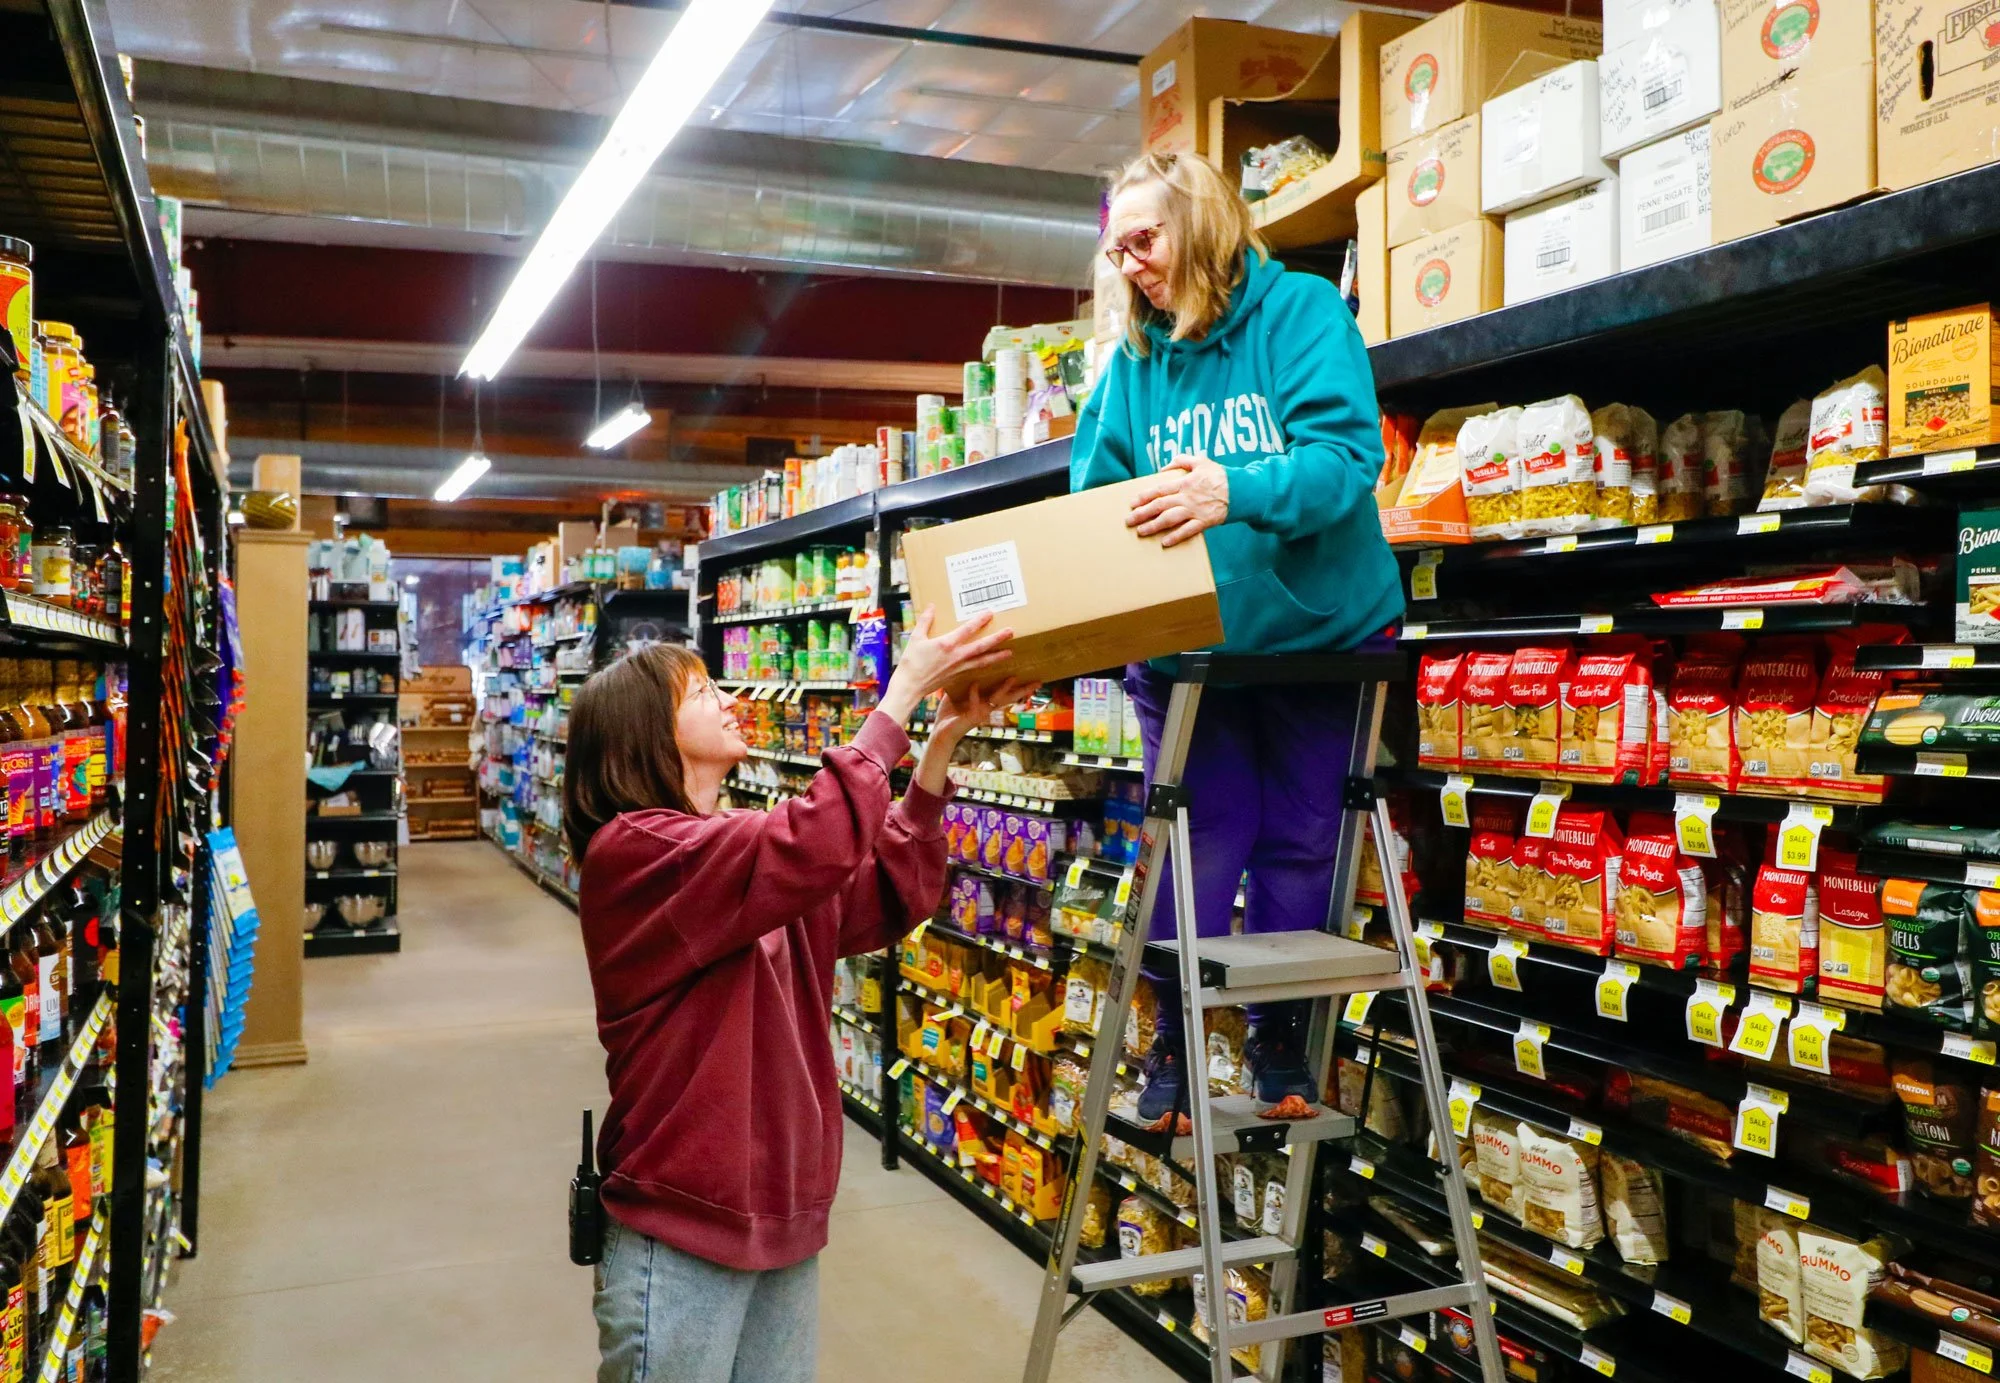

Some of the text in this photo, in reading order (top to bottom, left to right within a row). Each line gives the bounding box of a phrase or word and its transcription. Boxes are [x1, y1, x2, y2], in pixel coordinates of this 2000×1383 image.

[1900, 119, 1925, 135] PRODUCE
[1637, 184, 1692, 212] PENNE RIGATE
[1892, 315, 1984, 367] Bionaturae
[1905, 374, 1970, 390] SOURDOUGH
[970, 548, 1009, 562] MANTOVA
[1971, 566, 1997, 574] PENNE
[1512, 661, 1559, 675] MONTEBELLO
[1578, 663, 1626, 677] MONTEBELLO
[1745, 663, 1808, 678] MONTEBELLO
[1685, 825, 1702, 834] SALE
[1687, 840, 1706, 850] $3.99
[1789, 835, 1807, 843] SALE
[1626, 837, 1675, 859] MONTEBELLO
[1787, 850, 1806, 861] $3.99
[1762, 870, 1806, 885] MONTEBELLO
[1886, 895, 1914, 908] MANTOVA
[1833, 901, 1870, 922] Lasagne
[1604, 986, 1619, 996] SALE
[1603, 1001, 1619, 1011] $3.99
[1696, 1010, 1712, 1020] SALE
[1696, 1026, 1713, 1036] $3.99
[1750, 1021, 1768, 1032] SALE
[1743, 1037, 1765, 1049] $3.99
[1799, 1033, 1817, 1044] SALE
[1798, 1050, 1818, 1062] $6.49
[1749, 1116, 1767, 1128] SALE
[1474, 1134, 1510, 1156] RUMMO
[1747, 1132, 1767, 1145] $3.99
[1520, 1151, 1562, 1175] RUMMO
[1800, 1255, 1851, 1282] RUMMO
